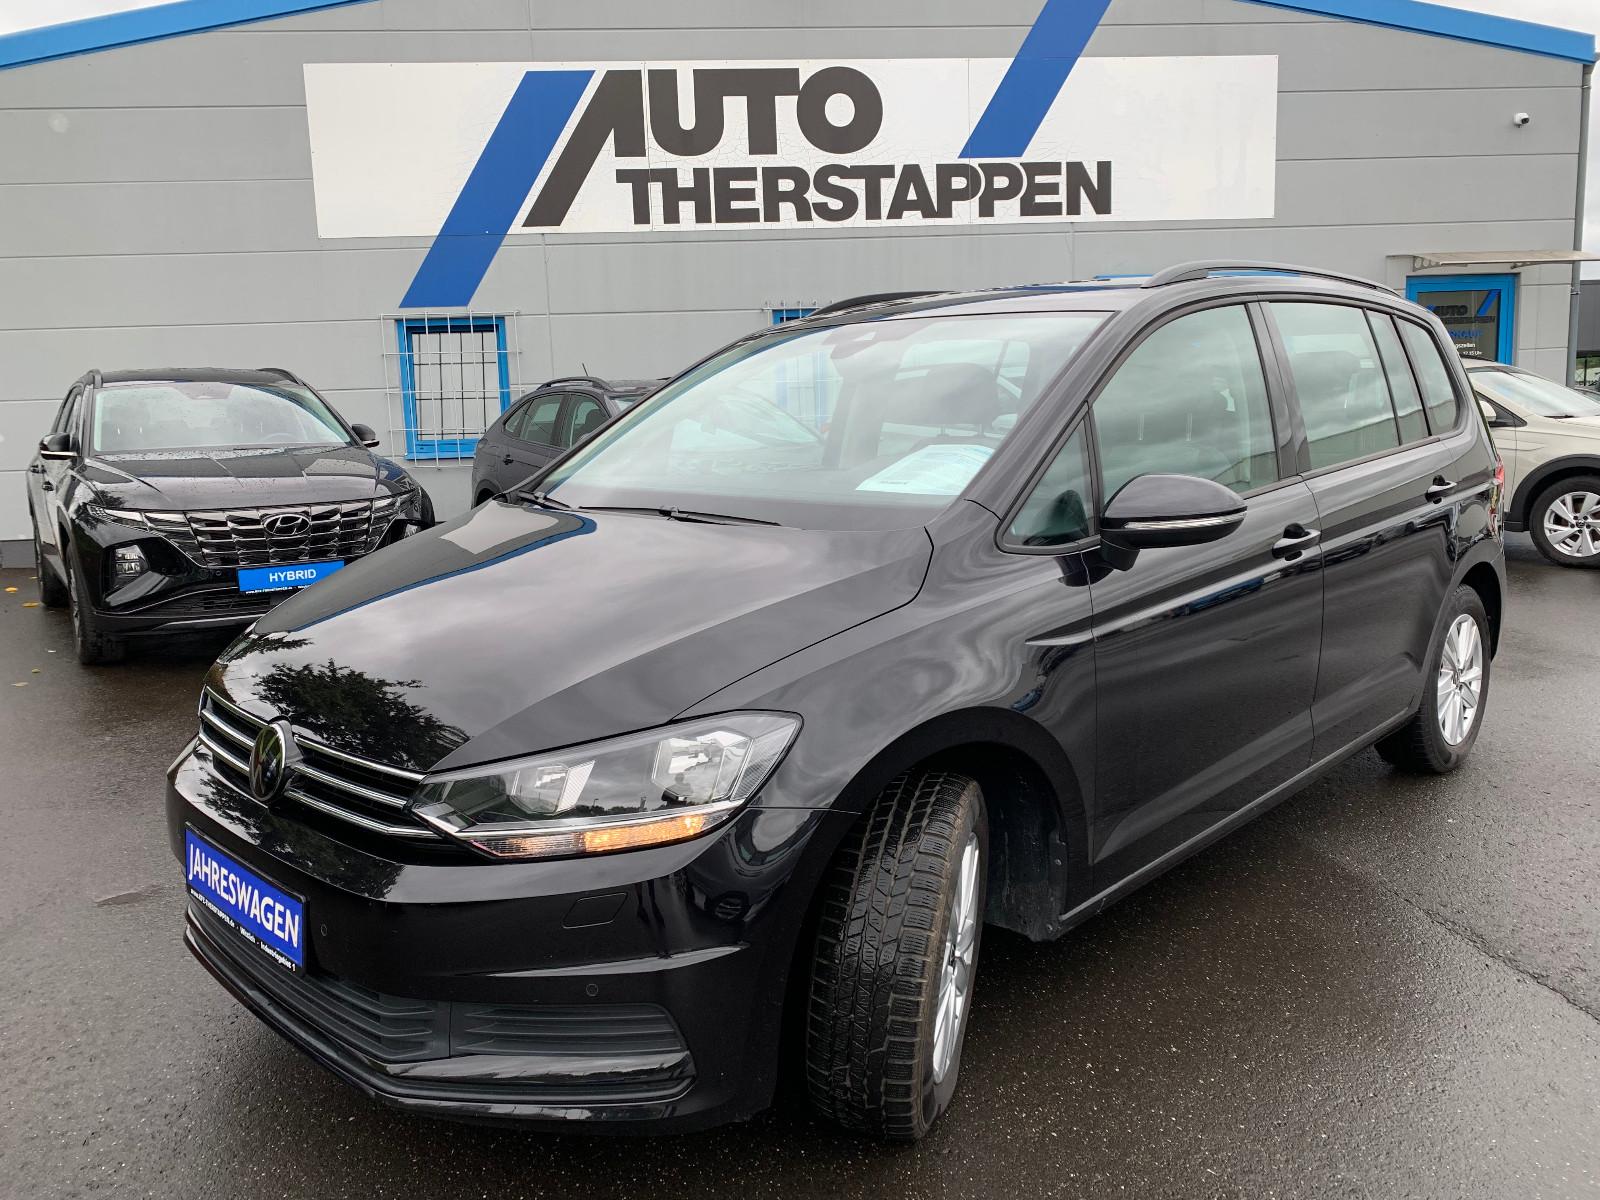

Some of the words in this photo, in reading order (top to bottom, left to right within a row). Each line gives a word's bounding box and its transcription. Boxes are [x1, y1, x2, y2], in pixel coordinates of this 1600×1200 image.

[522, 66, 883, 227] AUTO
[615, 160, 1112, 225] THERSTAPPEN
[269, 569, 317, 582] HYBRID
[188, 843, 299, 949] JAHRESWAGEN
